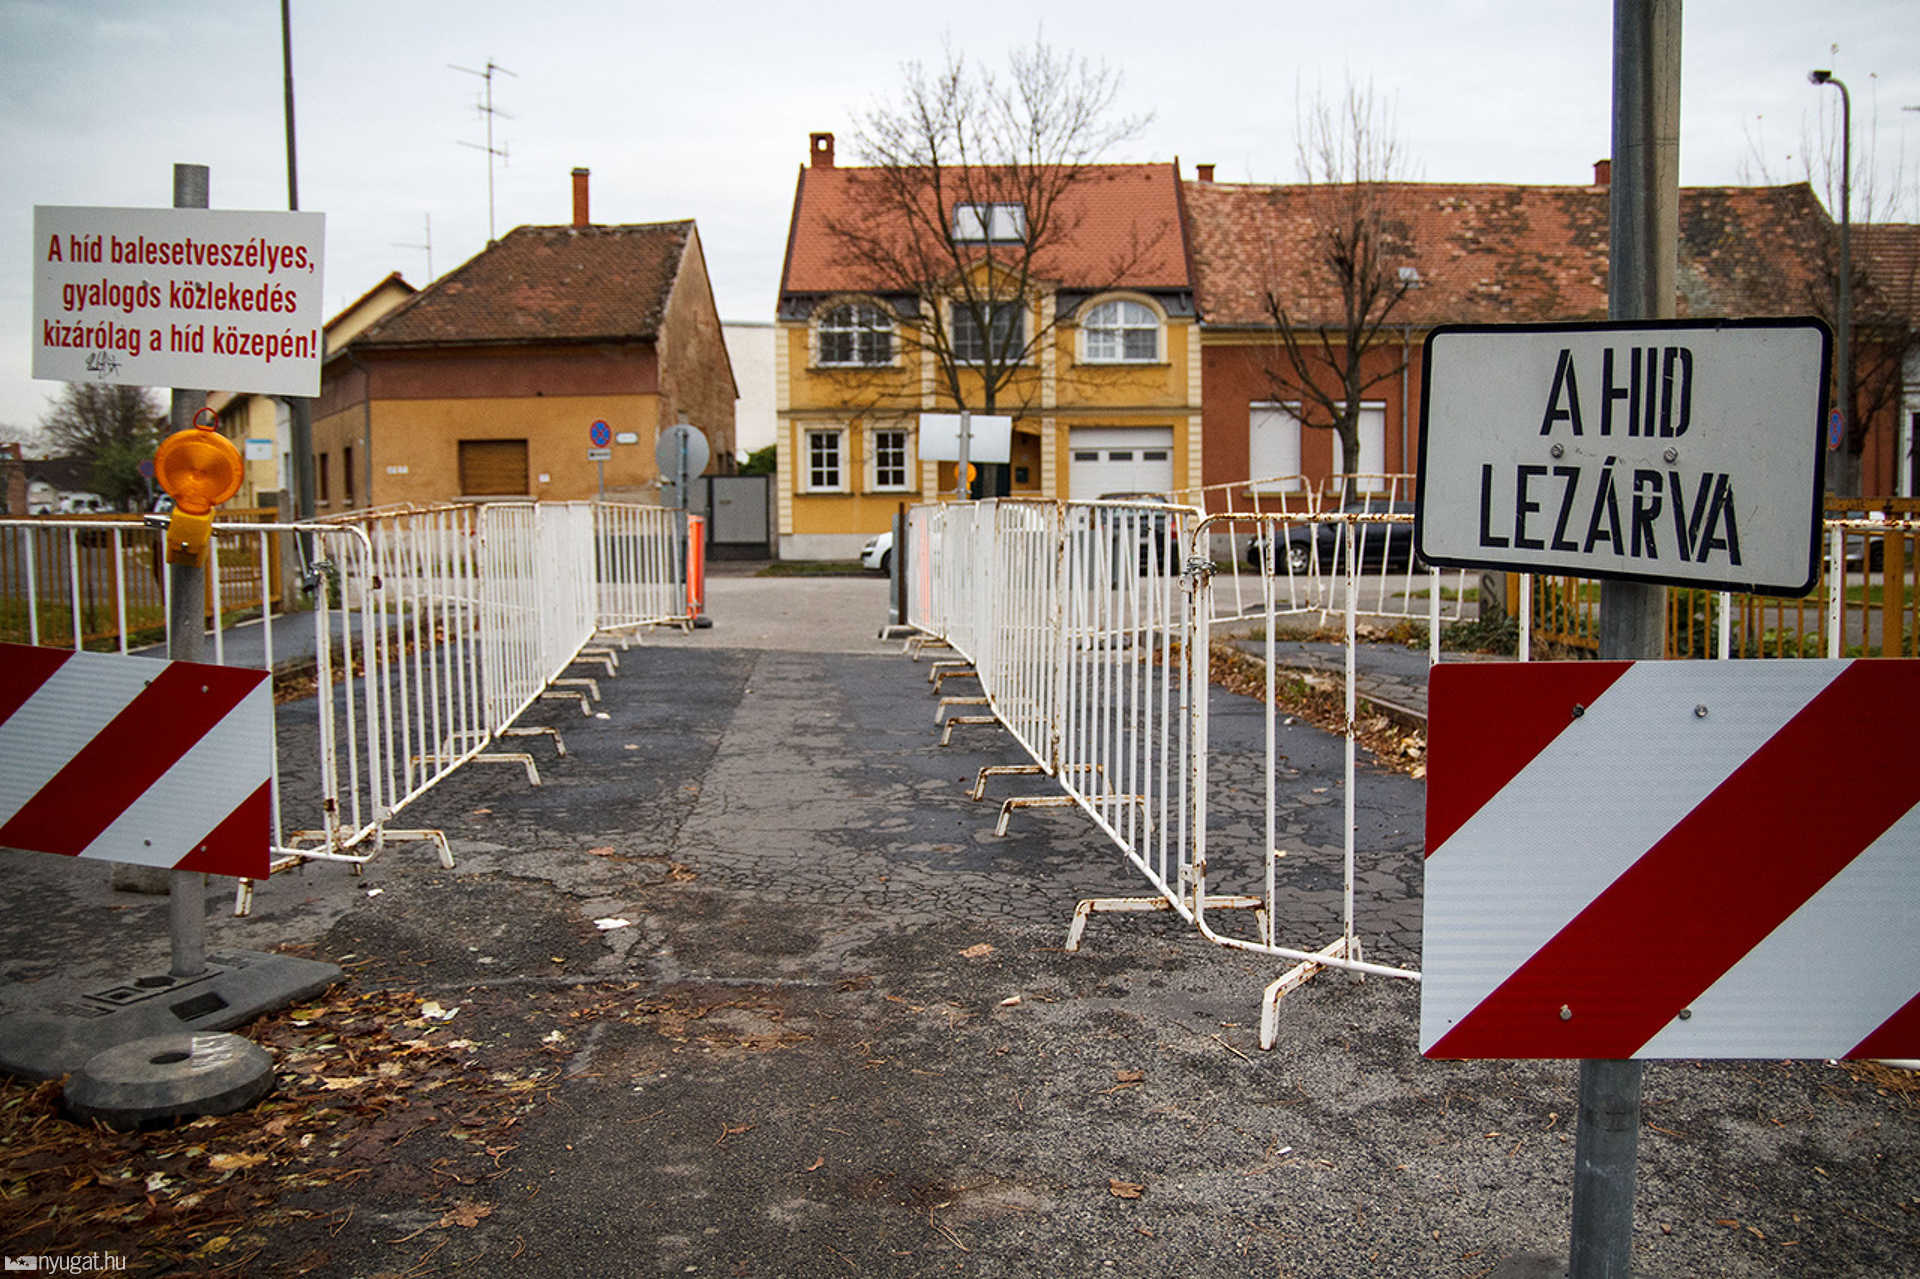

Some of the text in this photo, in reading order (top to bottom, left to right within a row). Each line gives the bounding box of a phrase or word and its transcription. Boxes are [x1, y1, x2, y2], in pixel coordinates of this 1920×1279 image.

[48, 234, 315, 274] A híd balesetveszélyes,
[63, 278, 297, 313] gyalogos közlekedés
[43, 319, 318, 363] kizárólag a híd közepén!
[1540, 346, 1693, 438] A HID
[1479, 455, 1742, 566] LEZÁRVA
